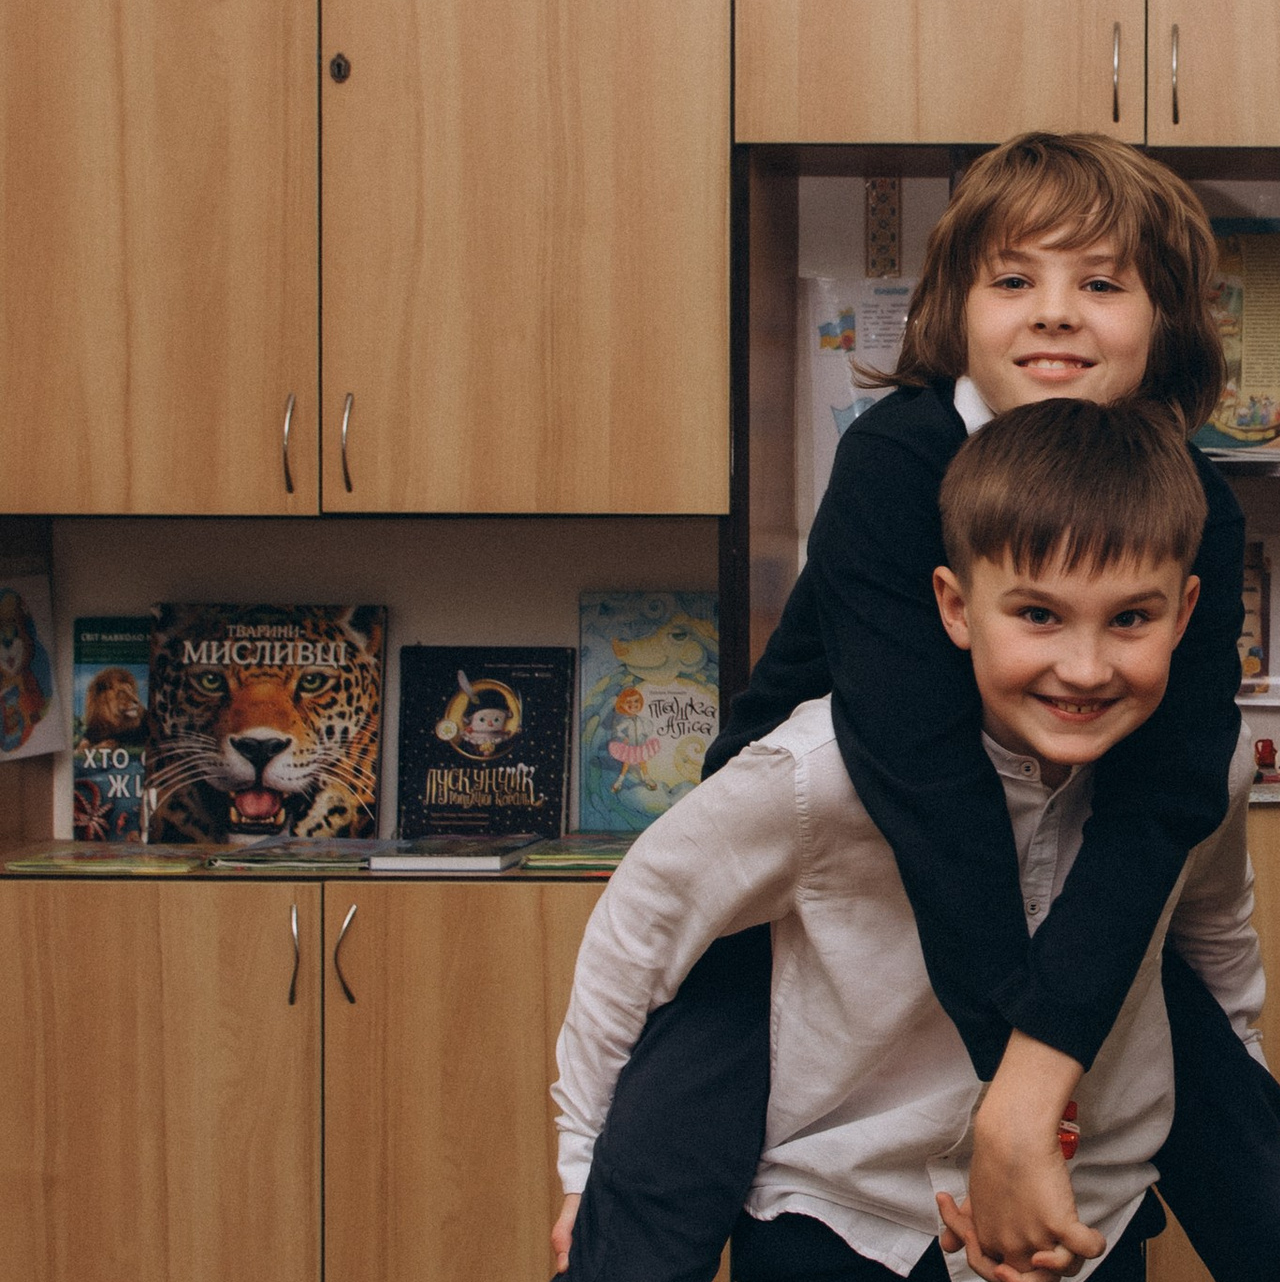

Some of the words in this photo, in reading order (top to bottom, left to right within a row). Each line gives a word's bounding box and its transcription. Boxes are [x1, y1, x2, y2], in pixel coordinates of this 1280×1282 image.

[226, 624, 306, 639] ТВАРИНИ-
[182, 640, 348, 670] МИСЛИВЦІ
[83, 747, 130, 769] ХТО
